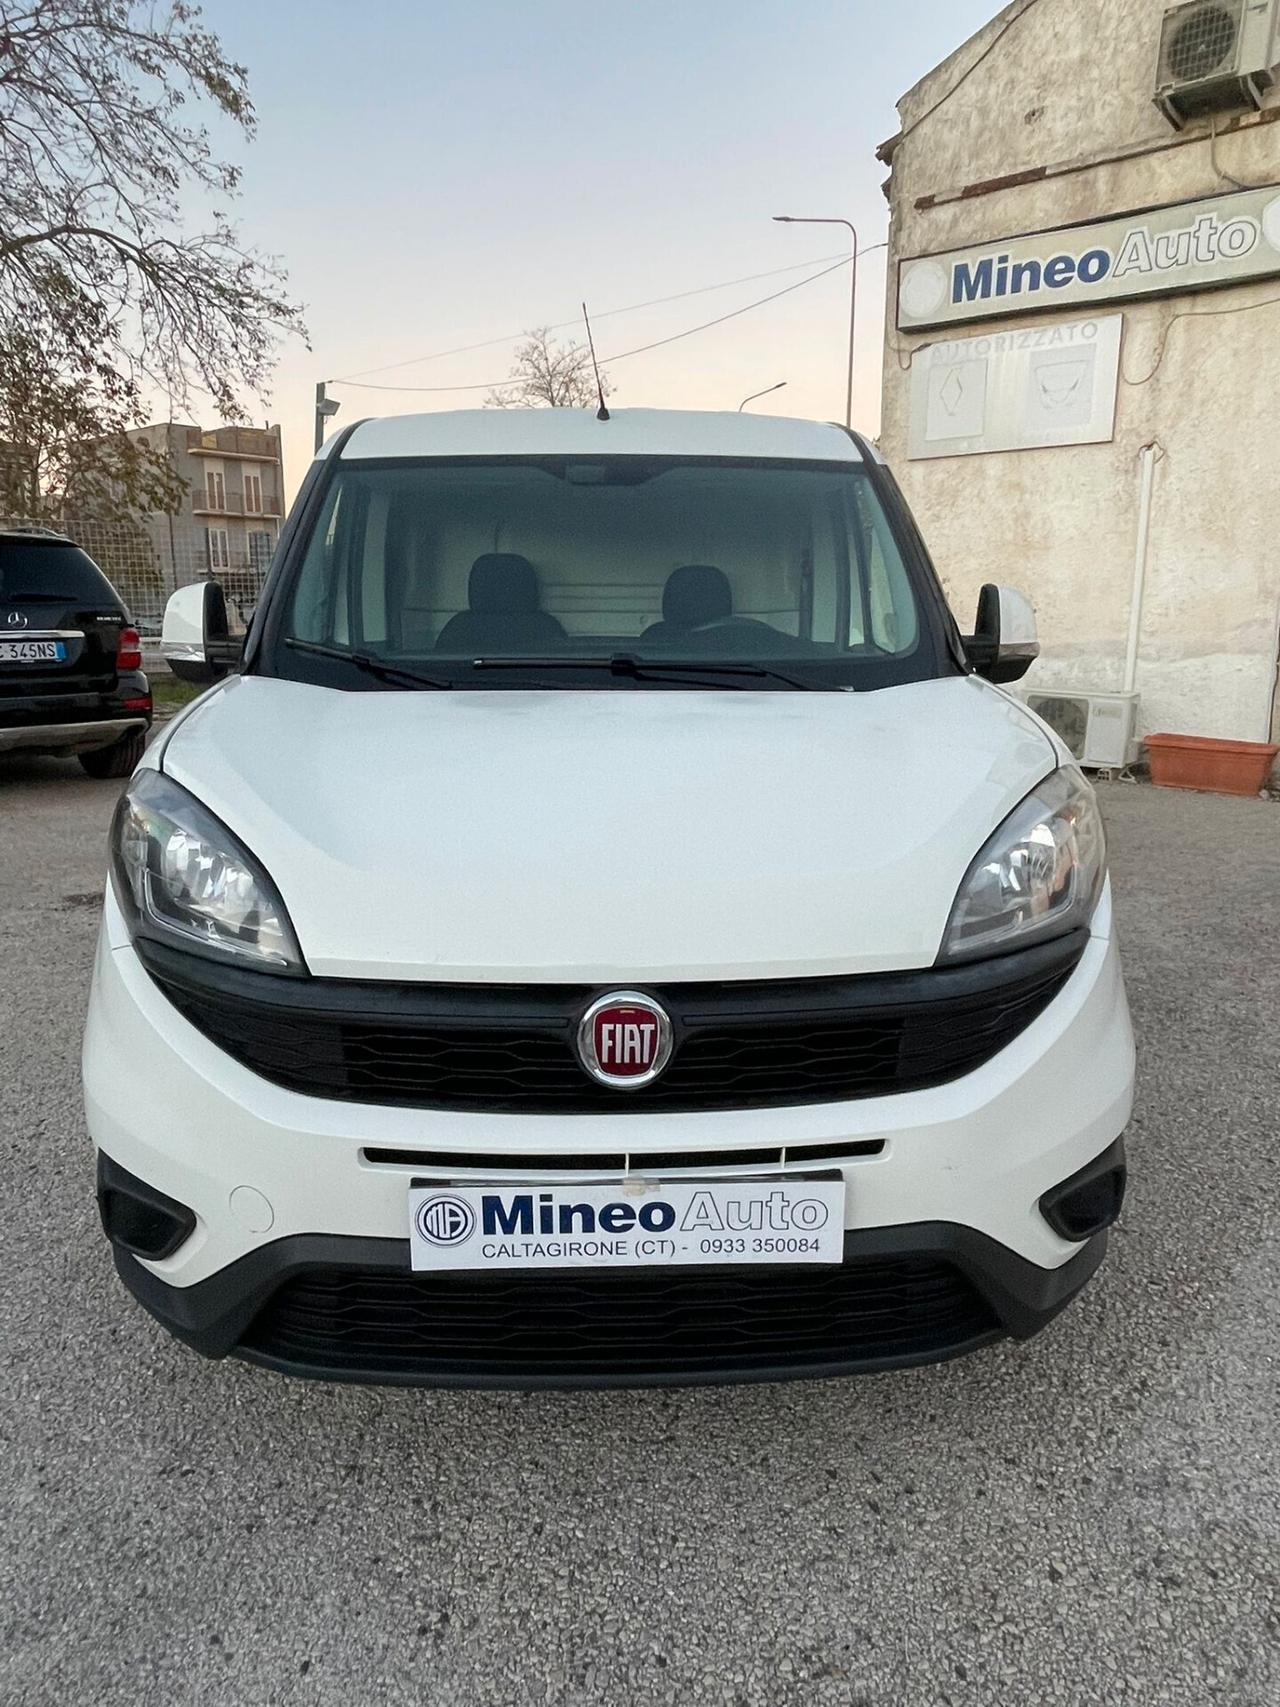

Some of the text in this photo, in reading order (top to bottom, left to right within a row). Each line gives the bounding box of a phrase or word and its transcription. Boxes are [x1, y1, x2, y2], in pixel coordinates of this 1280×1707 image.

[930, 322, 1098, 359] AUTORIZZATO
[601, 1023, 656, 1064] FIAT
[483, 1241, 627, 1258] CALTAGIRONE
[700, 1238, 746, 1253] 0933
[752, 1237, 821, 1253] 350084
